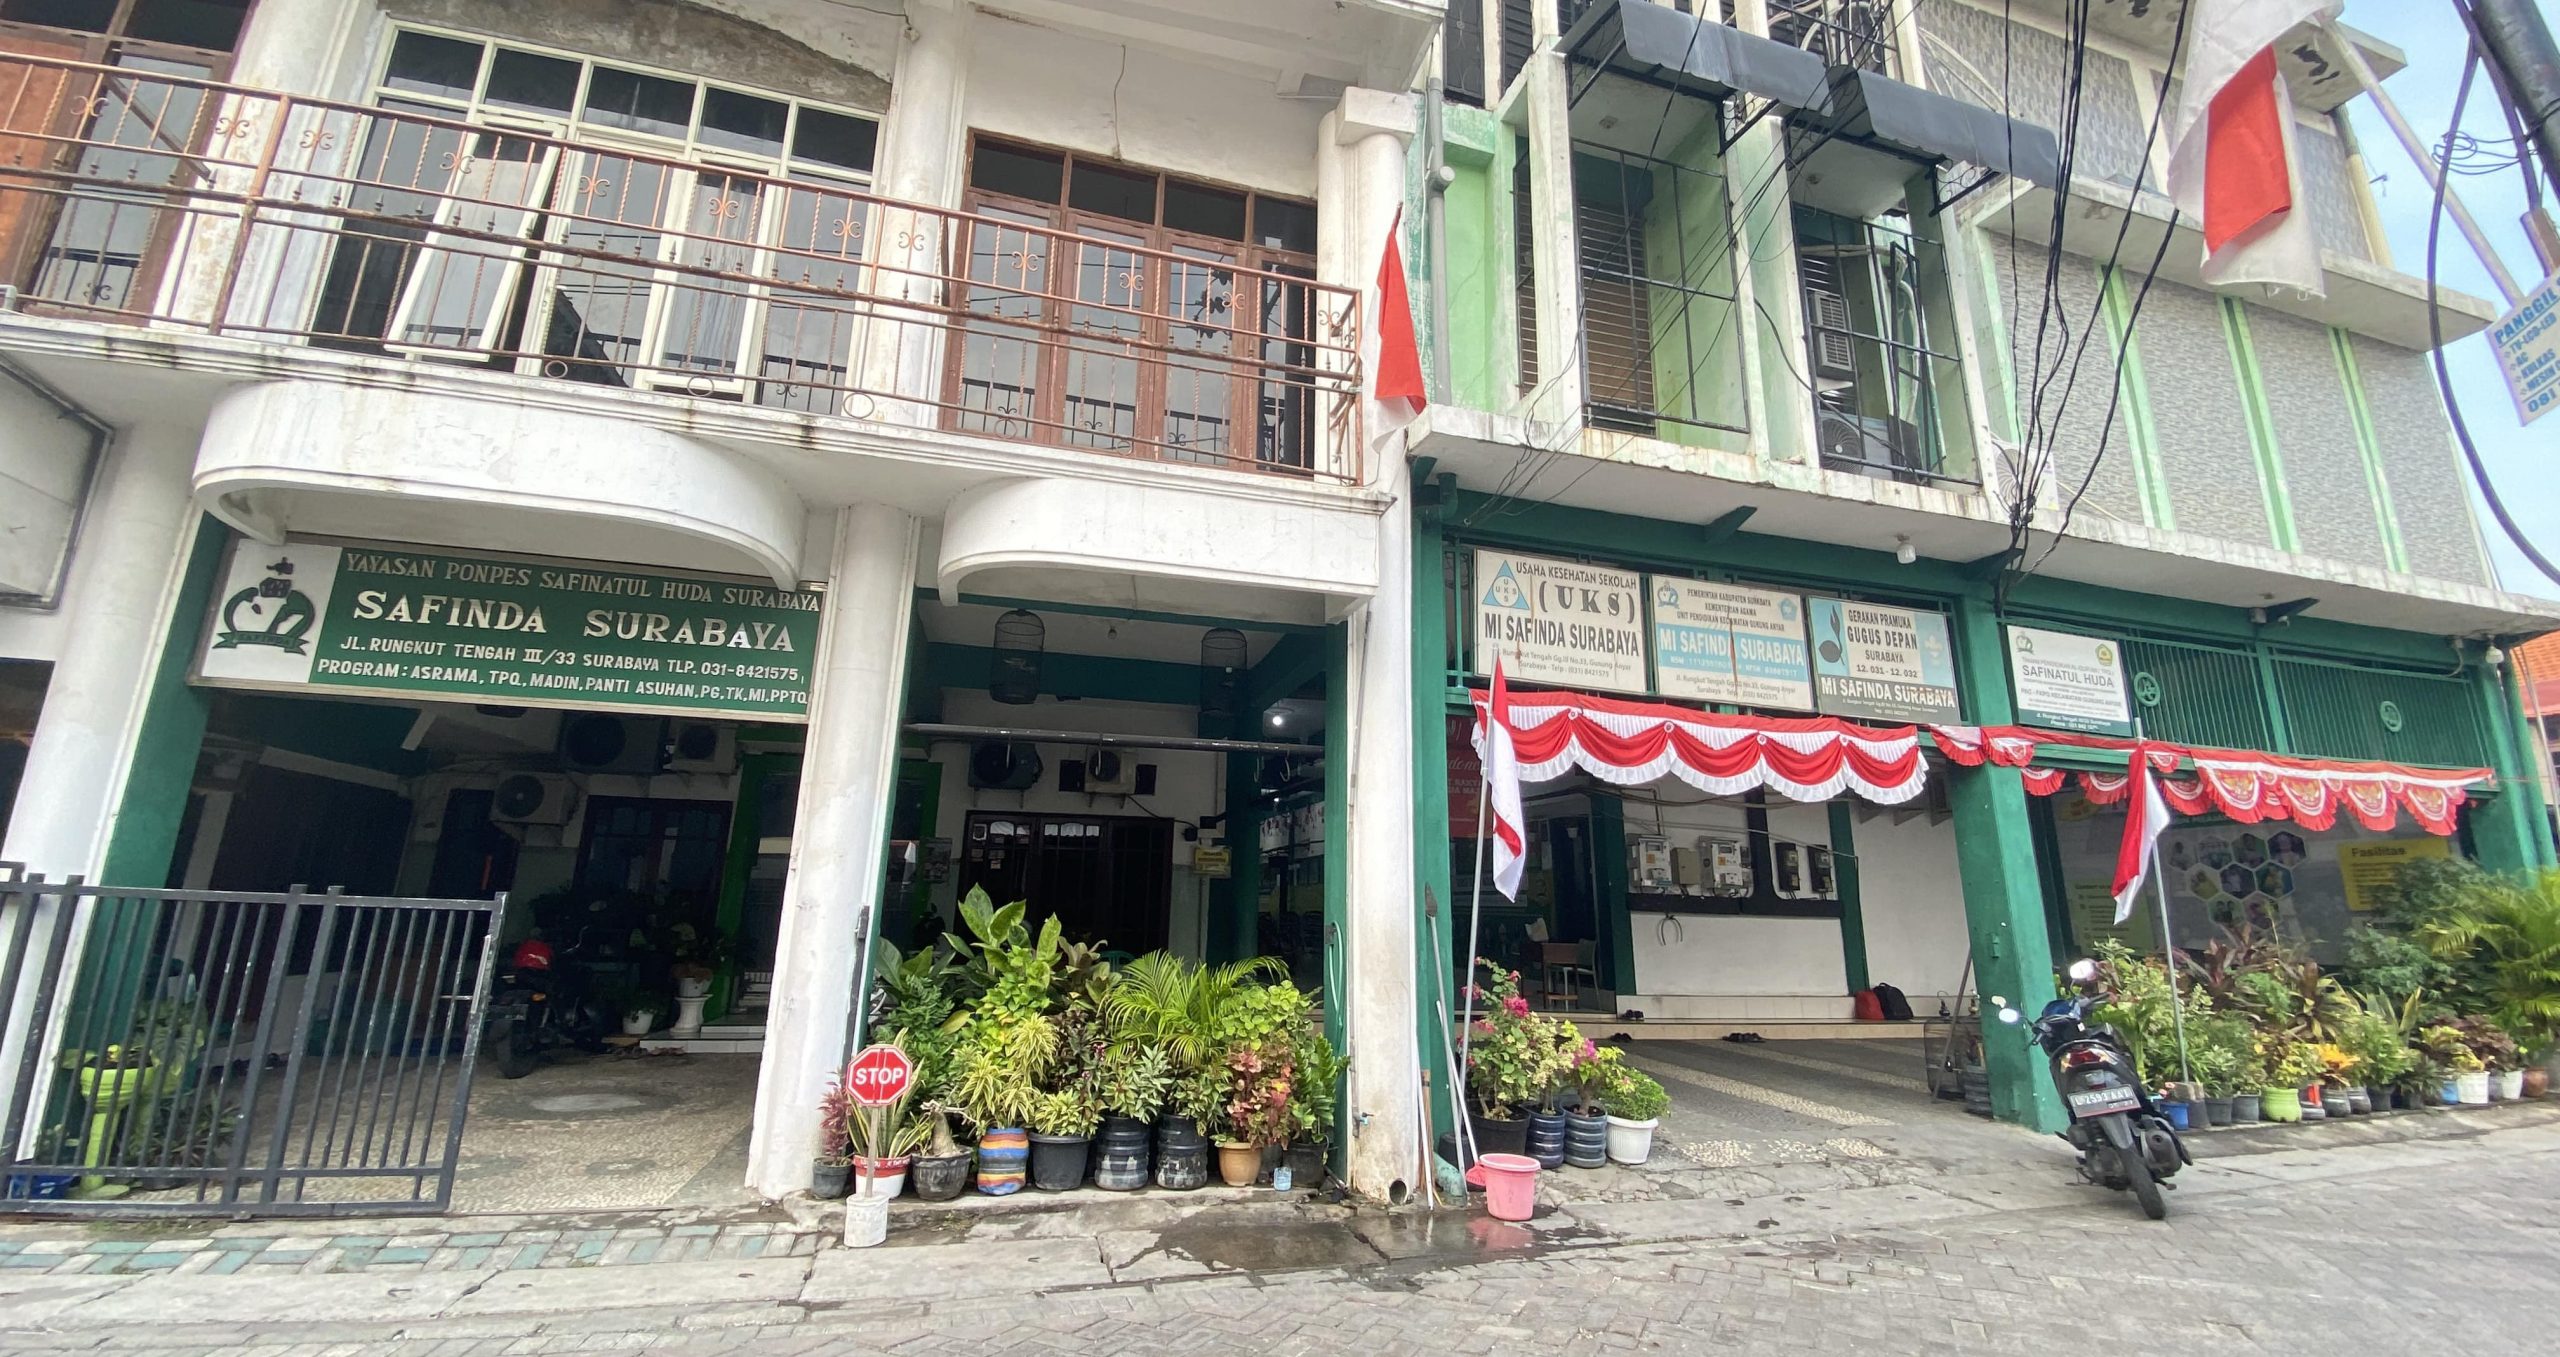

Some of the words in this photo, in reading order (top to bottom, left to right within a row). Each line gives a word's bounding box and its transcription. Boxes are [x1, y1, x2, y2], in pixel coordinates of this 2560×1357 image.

[2494, 287, 2558, 344] PANGGIL
[347, 553, 436, 578] YAYASAN
[446, 562, 532, 586] PONPES
[539, 571, 652, 597] SAFINATUL
[661, 581, 713, 603] HUDA
[722, 588, 820, 612] SURABAYA
[1516, 561, 1547, 577] USAHA
[1548, 566, 1597, 585] KESEHATAN
[1599, 573, 1637, 590] SEKOLAH
[1687, 588, 1718, 600] PEMERINTAH
[353, 590, 547, 633] SAFINDA
[583, 609, 794, 652] SURABAYA
[1677, 611, 1689, 620] UNIT
[1690, 612, 1719, 624] PENDIDIKAN
[1740, 606, 1757, 617] AGAMA
[1848, 609, 1879, 625] GERAKAN
[1880, 613, 1912, 629] PRAMUKA
[1485, 612, 1501, 640] MI
[1506, 615, 1566, 648] SAFINDA
[1569, 622, 1640, 657] SURABAYA
[1847, 625, 1881, 646] GUGUS
[1884, 630, 1918, 650] DEPAN
[341, 636, 366, 651] JL.
[369, 637, 446, 656] RUNGKUT
[454, 643, 516, 661] TENGAH
[582, 653, 659, 672] SURABAYA
[667, 659, 697, 675] TLP.
[700, 662, 799, 681] 031-8421575
[1530, 651, 1552, 662] Tengah
[1660, 628, 1677, 651] MI
[1740, 637, 1804, 667] SURABAYA
[1865, 649, 1905, 664] SURABAYA
[2022, 664, 2082, 684] SAFINATUL
[2084, 673, 2114, 688] HUDA
[1821, 677, 1837, 695] MI
[1840, 678, 1893, 701] SAFINDA
[1894, 684, 1955, 708] SURABAYA
[855, 1067, 904, 1085] STOP
